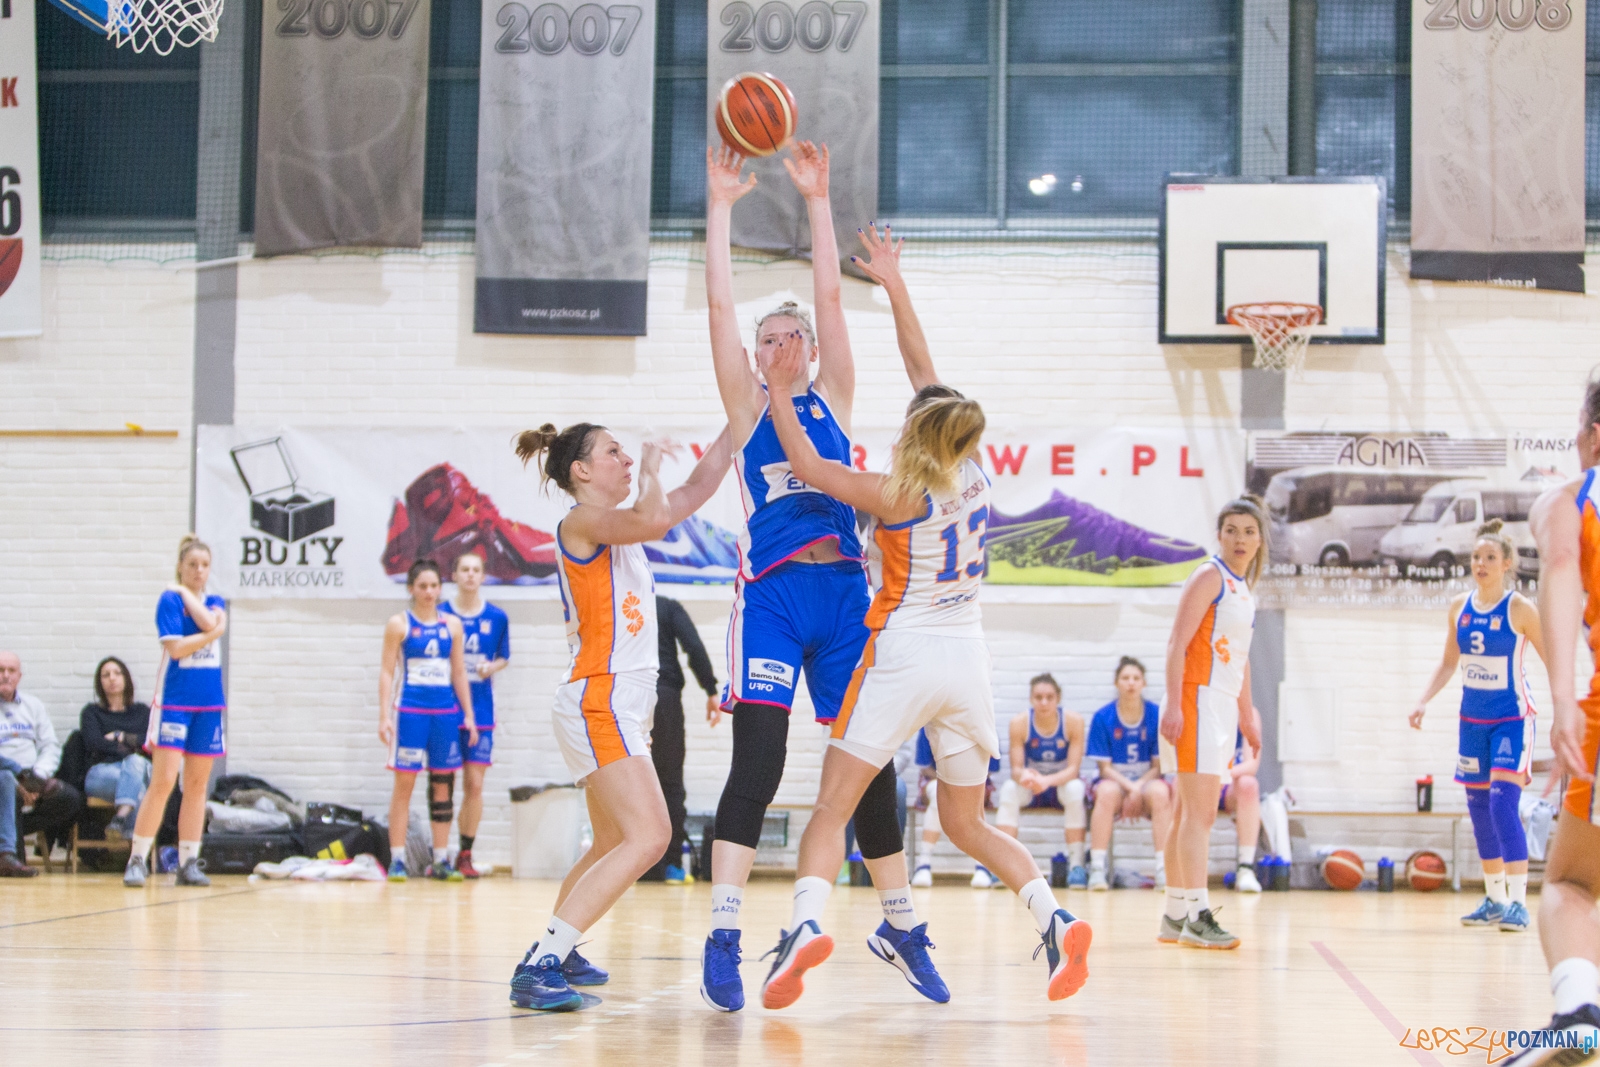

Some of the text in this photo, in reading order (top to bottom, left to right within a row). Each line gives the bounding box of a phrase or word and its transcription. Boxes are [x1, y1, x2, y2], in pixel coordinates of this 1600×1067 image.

[276, 0, 418, 40] 2007
[720, 1, 867, 53] 2007
[1424, 0, 1572, 31] 2008
[495, 2, 642, 56] 2007
[521, 307, 600, 320] www.pzkosz.pl
[1337, 437, 1425, 466] AGMA
[1513, 438, 1577, 451] TRANSP
[240, 537, 344, 566] BUTY
[935, 503, 987, 583] 13
[239, 571, 344, 587] MARKOWE
[1261, 563, 1297, 575] 2-060
[1407, 565, 1444, 577] Prusa
[1451, 565, 1465, 577] 19
[424, 639, 439, 658] 4
[1470, 631, 1485, 654] 3
[1467, 669, 1498, 681] Enea
[1127, 744, 1139, 763] 5
